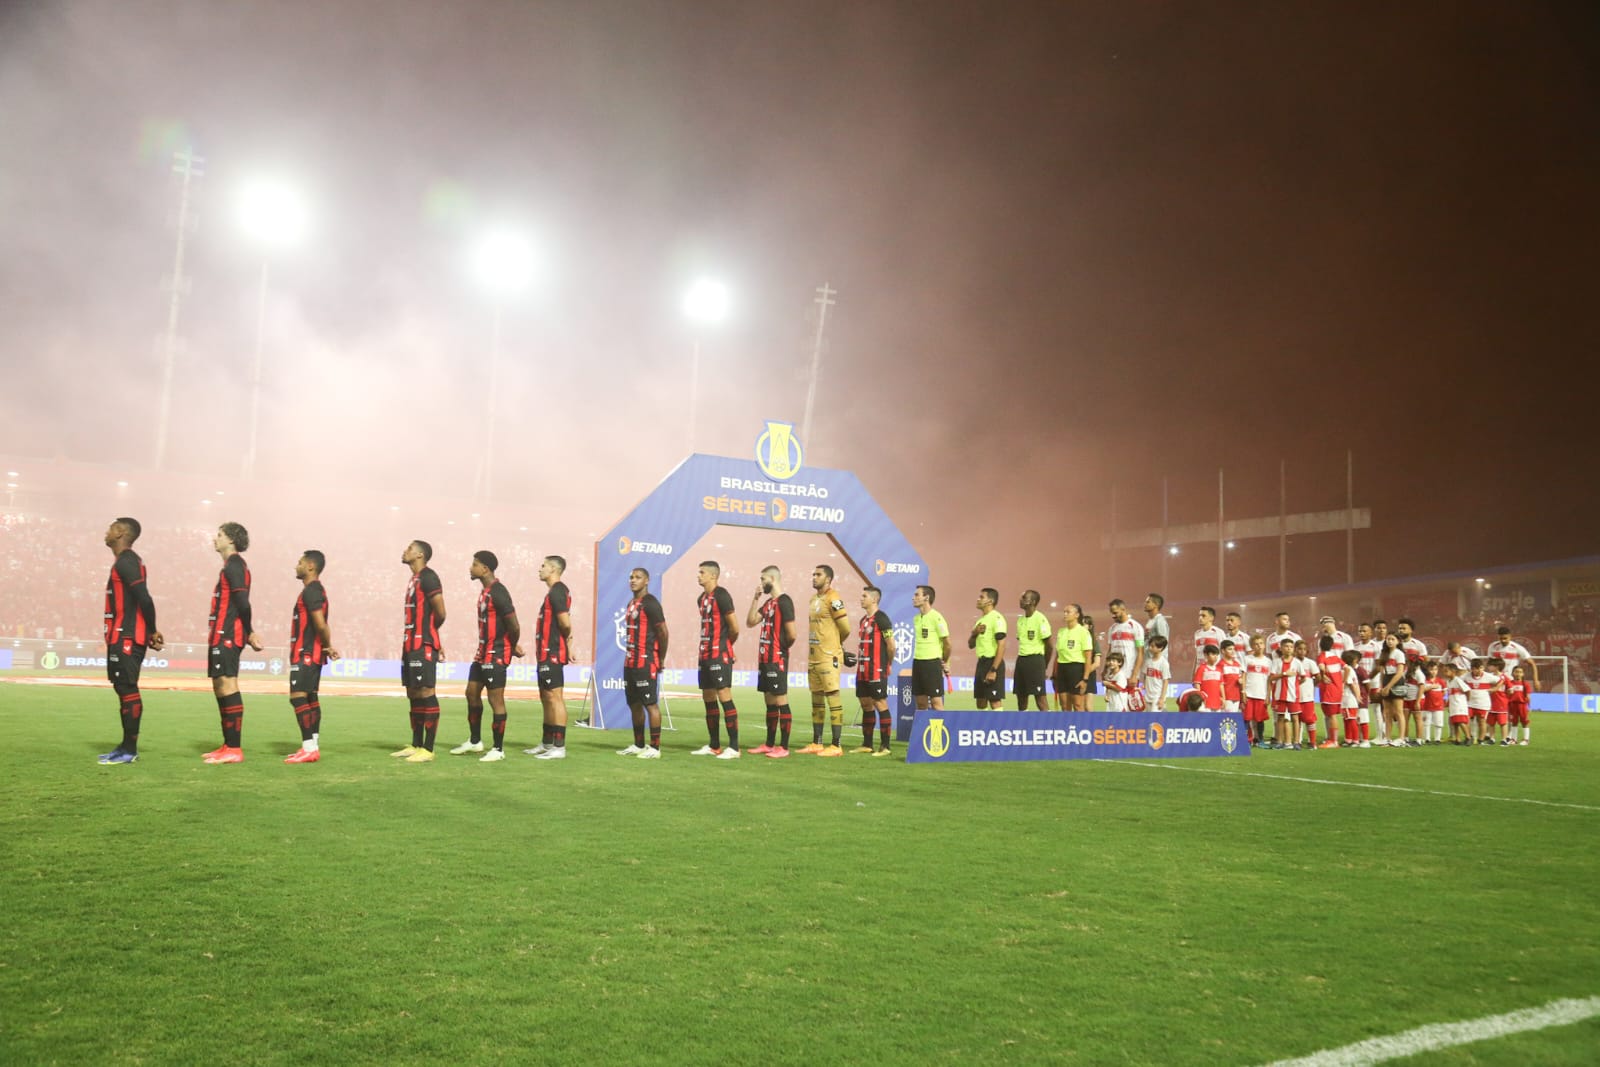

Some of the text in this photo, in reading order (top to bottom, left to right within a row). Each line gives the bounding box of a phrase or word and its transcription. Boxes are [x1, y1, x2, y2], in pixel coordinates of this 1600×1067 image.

[720, 476, 828, 499] BRASILEIRÃO
[702, 494, 845, 523] SÉRIE BETANO
[631, 541, 673, 556] BETANO
[885, 562, 920, 574] BETANO
[331, 661, 369, 677] CBF
[662, 669, 684, 685] BF
[732, 671, 751, 686] BF
[787, 672, 809, 688] CB
[958, 723, 1212, 747] BRASILEIRÃO SÉRIE BETANO
